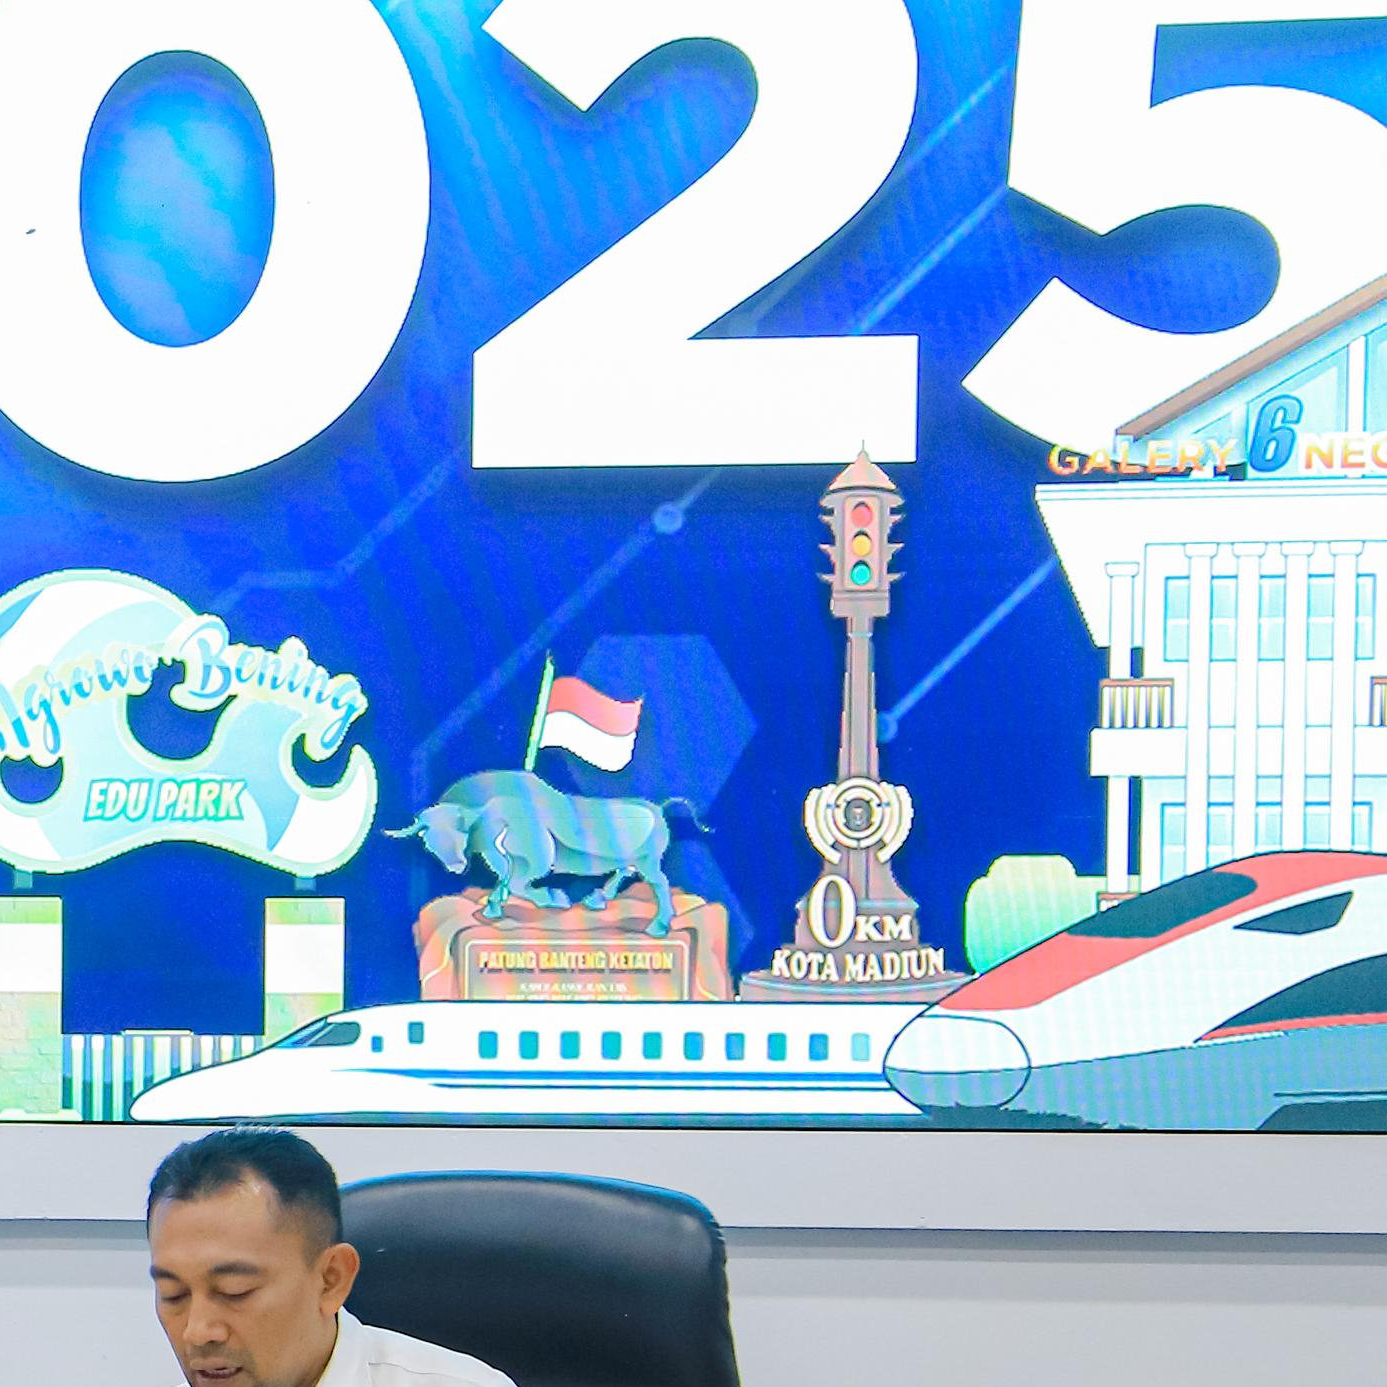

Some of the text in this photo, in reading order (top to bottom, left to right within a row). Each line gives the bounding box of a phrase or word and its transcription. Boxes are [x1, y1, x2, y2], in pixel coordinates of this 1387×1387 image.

[1047, 438, 1238, 476] GALERY
[1248, 394, 1304, 473] 6
[173, 619, 365, 750] Bening
[83, 779, 247, 821] EDU PARK
[479, 951, 536, 972] PATUNG
[538, 951, 607, 972] BANTENG
[771, 947, 946, 983] KOTA MADIUN
